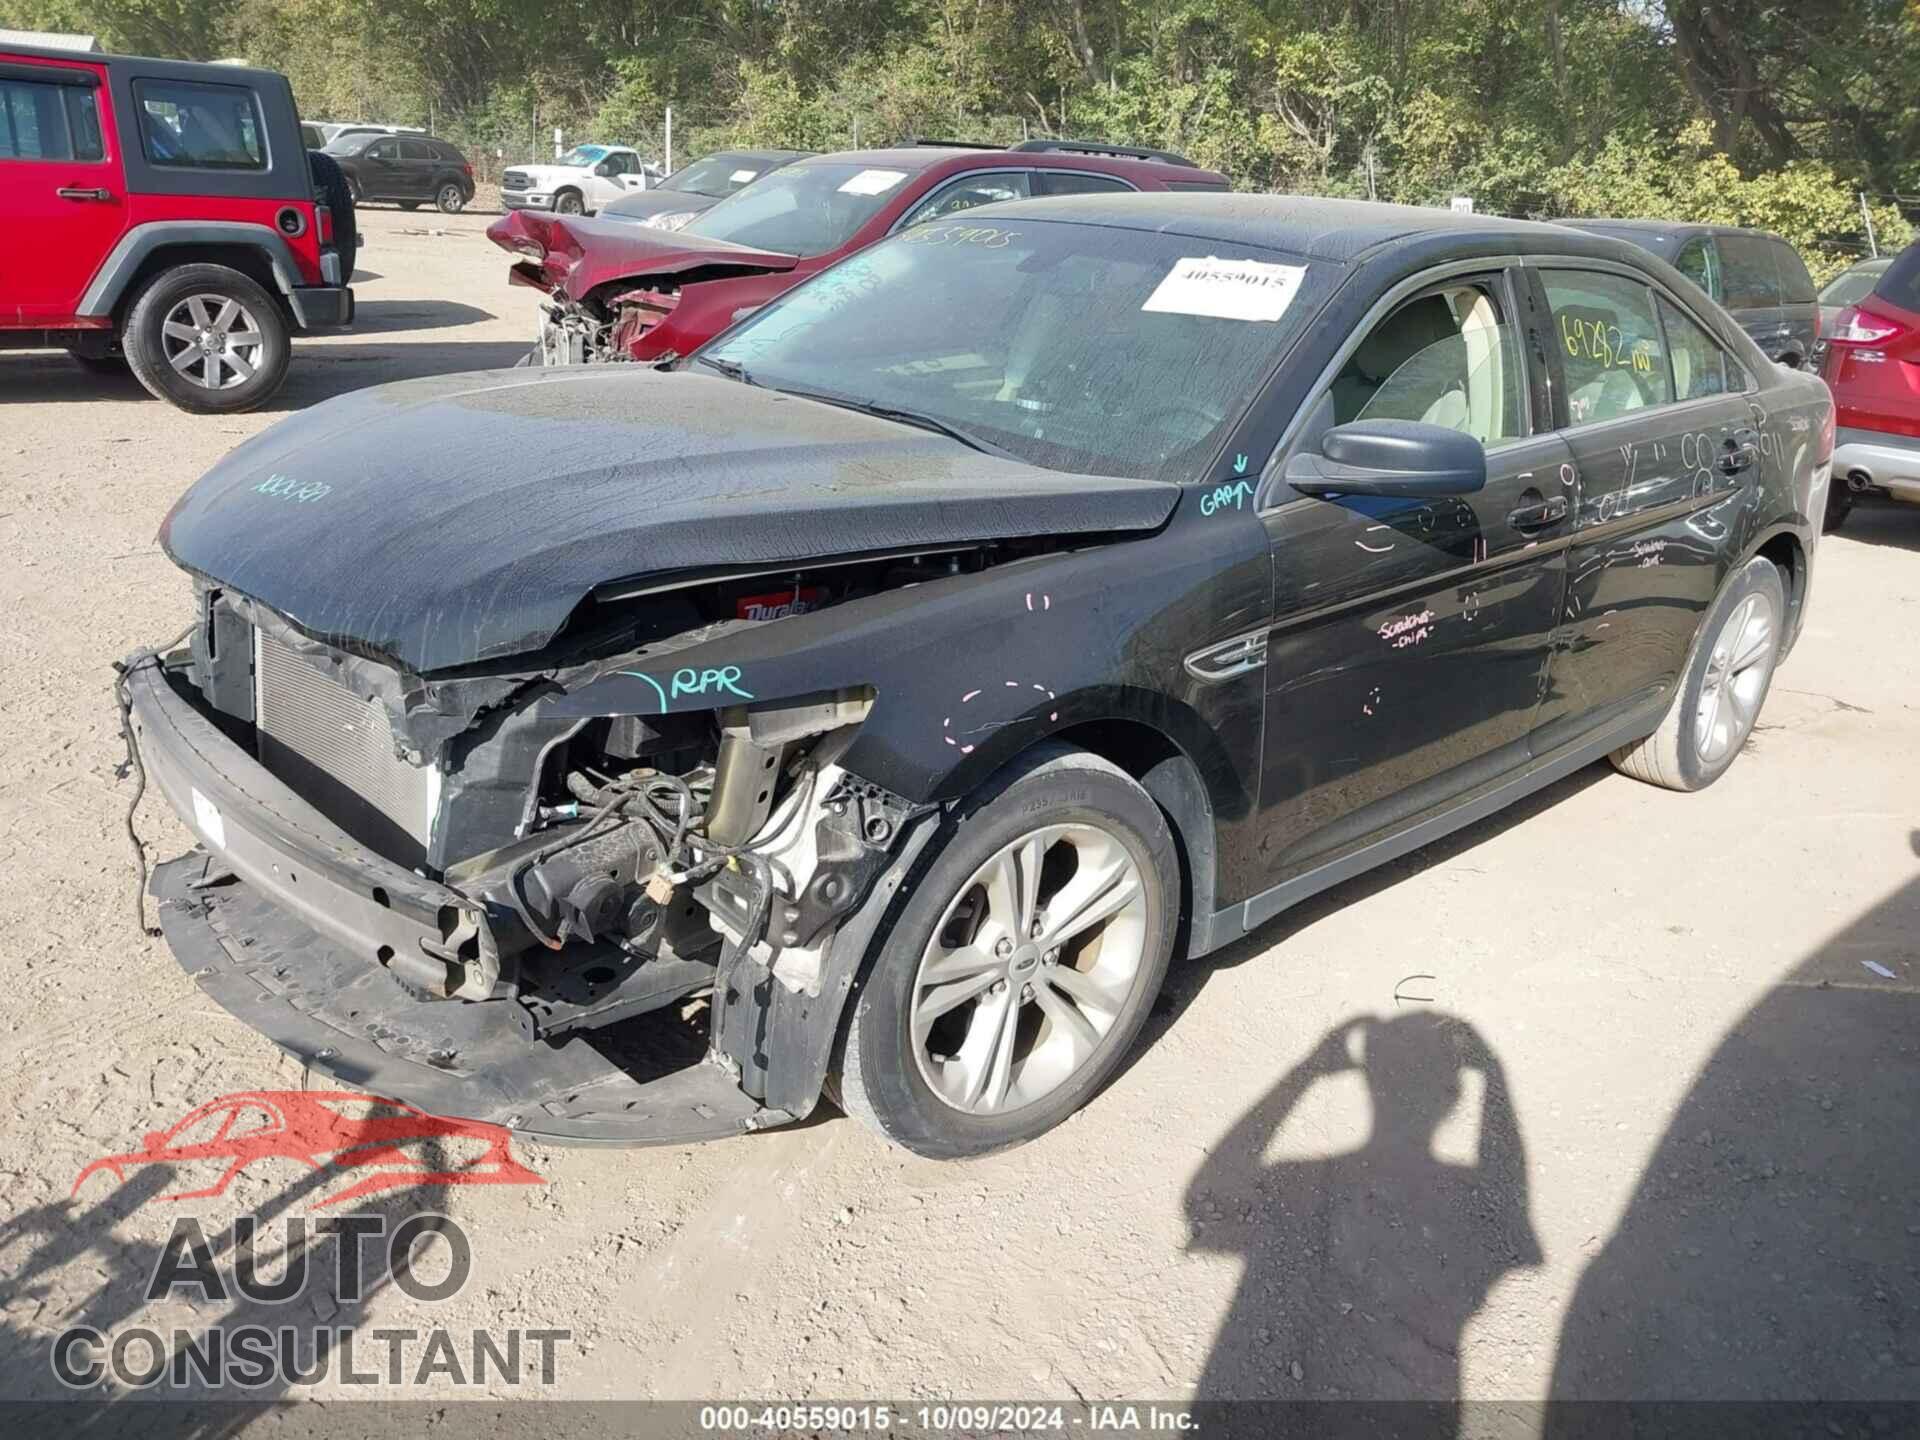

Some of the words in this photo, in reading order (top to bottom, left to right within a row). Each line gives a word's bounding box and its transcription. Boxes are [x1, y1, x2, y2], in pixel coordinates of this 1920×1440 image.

[1182, 269, 1288, 289] 40559015
[1562, 315, 1632, 368] 69282
[1200, 485, 1233, 516] GAP
[671, 666, 754, 698] RPR
